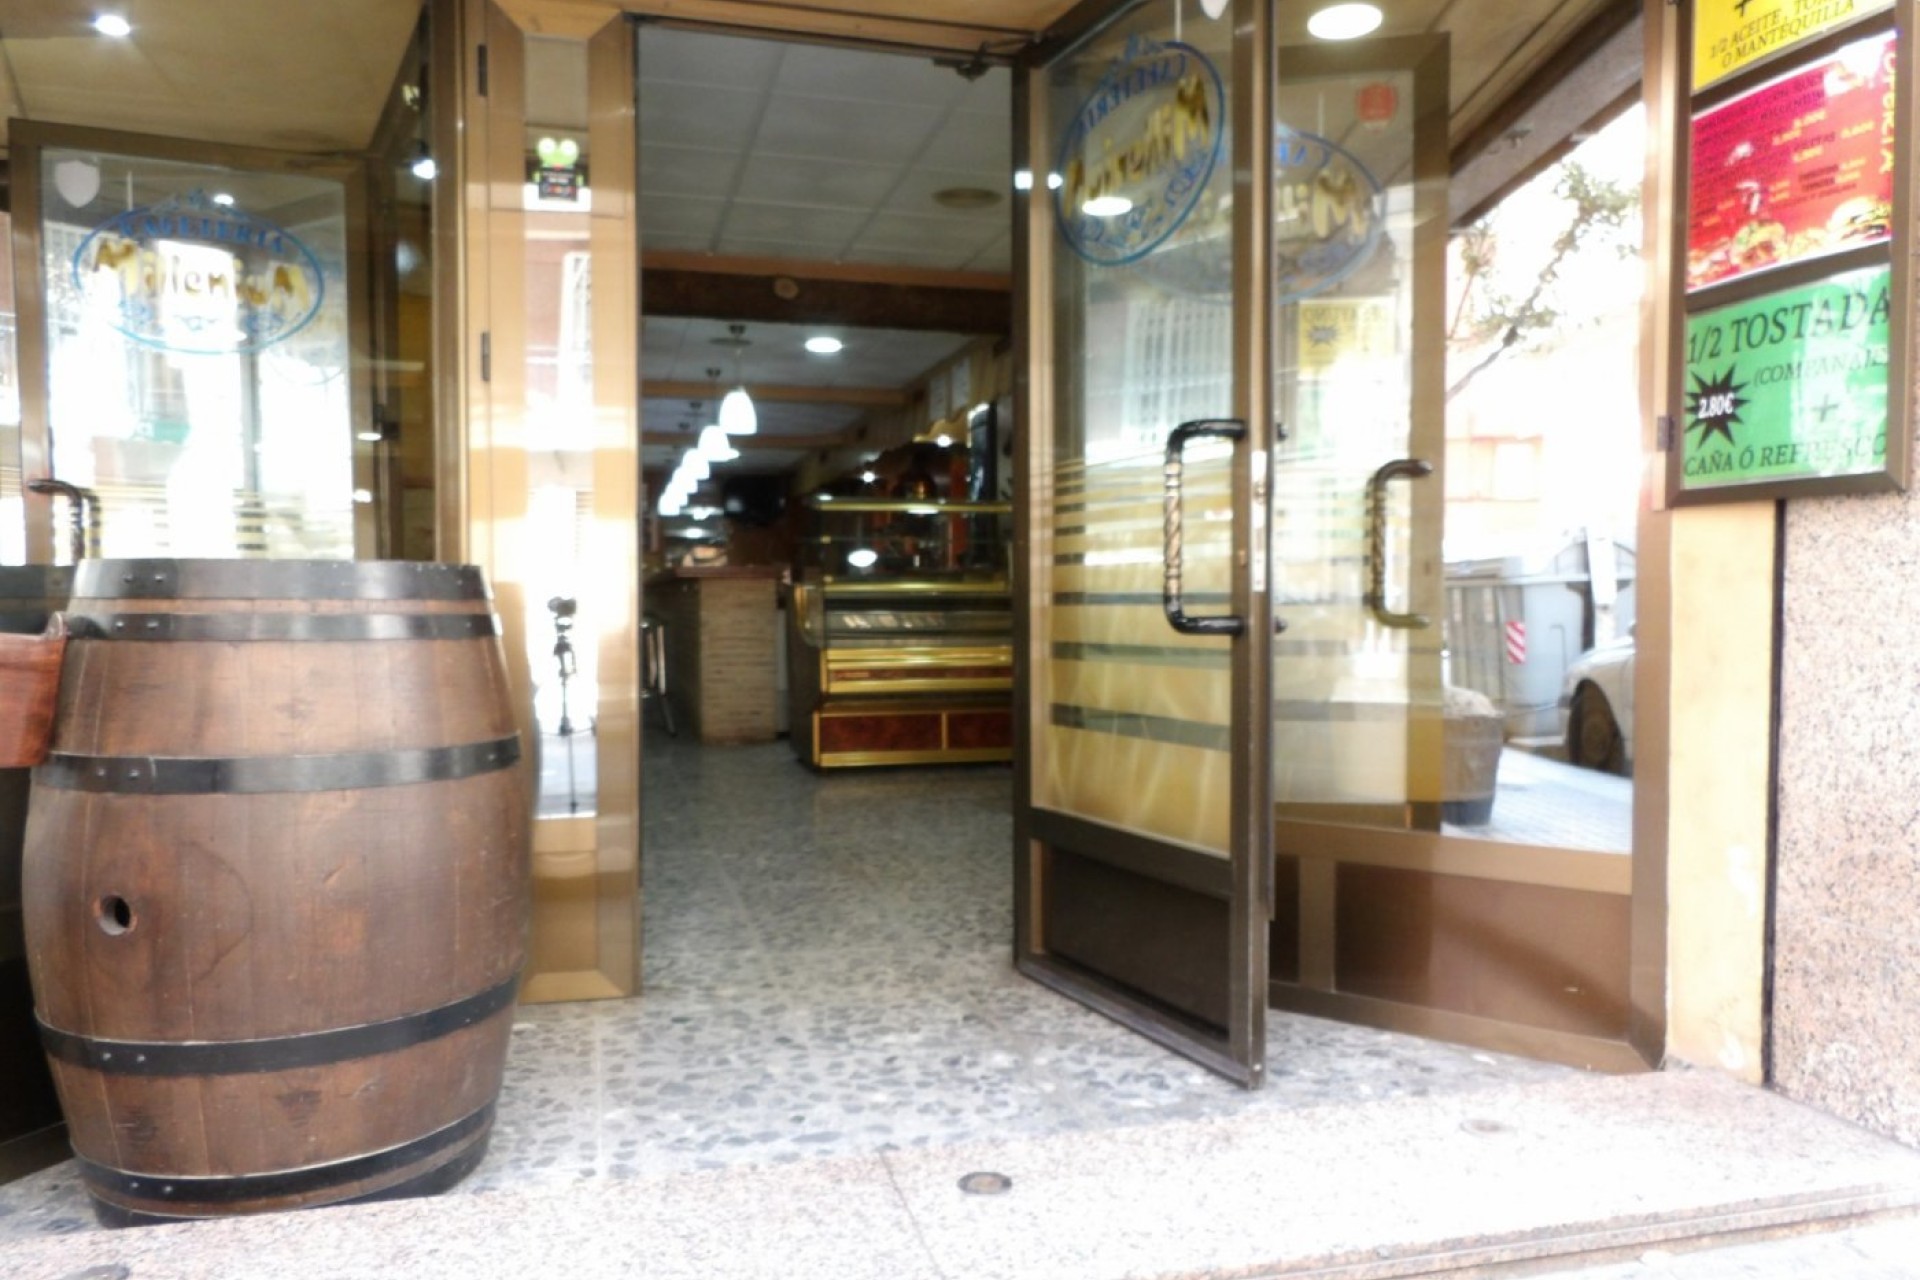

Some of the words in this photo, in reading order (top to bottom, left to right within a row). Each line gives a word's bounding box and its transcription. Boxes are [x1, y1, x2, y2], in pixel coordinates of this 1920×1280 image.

[1733, 0, 1854, 63] MANTEQUILLA
[1687, 325, 1722, 365] 1/2
[1731, 286, 1890, 353] TOSTADA
[1685, 451, 1732, 476] CAÑA
